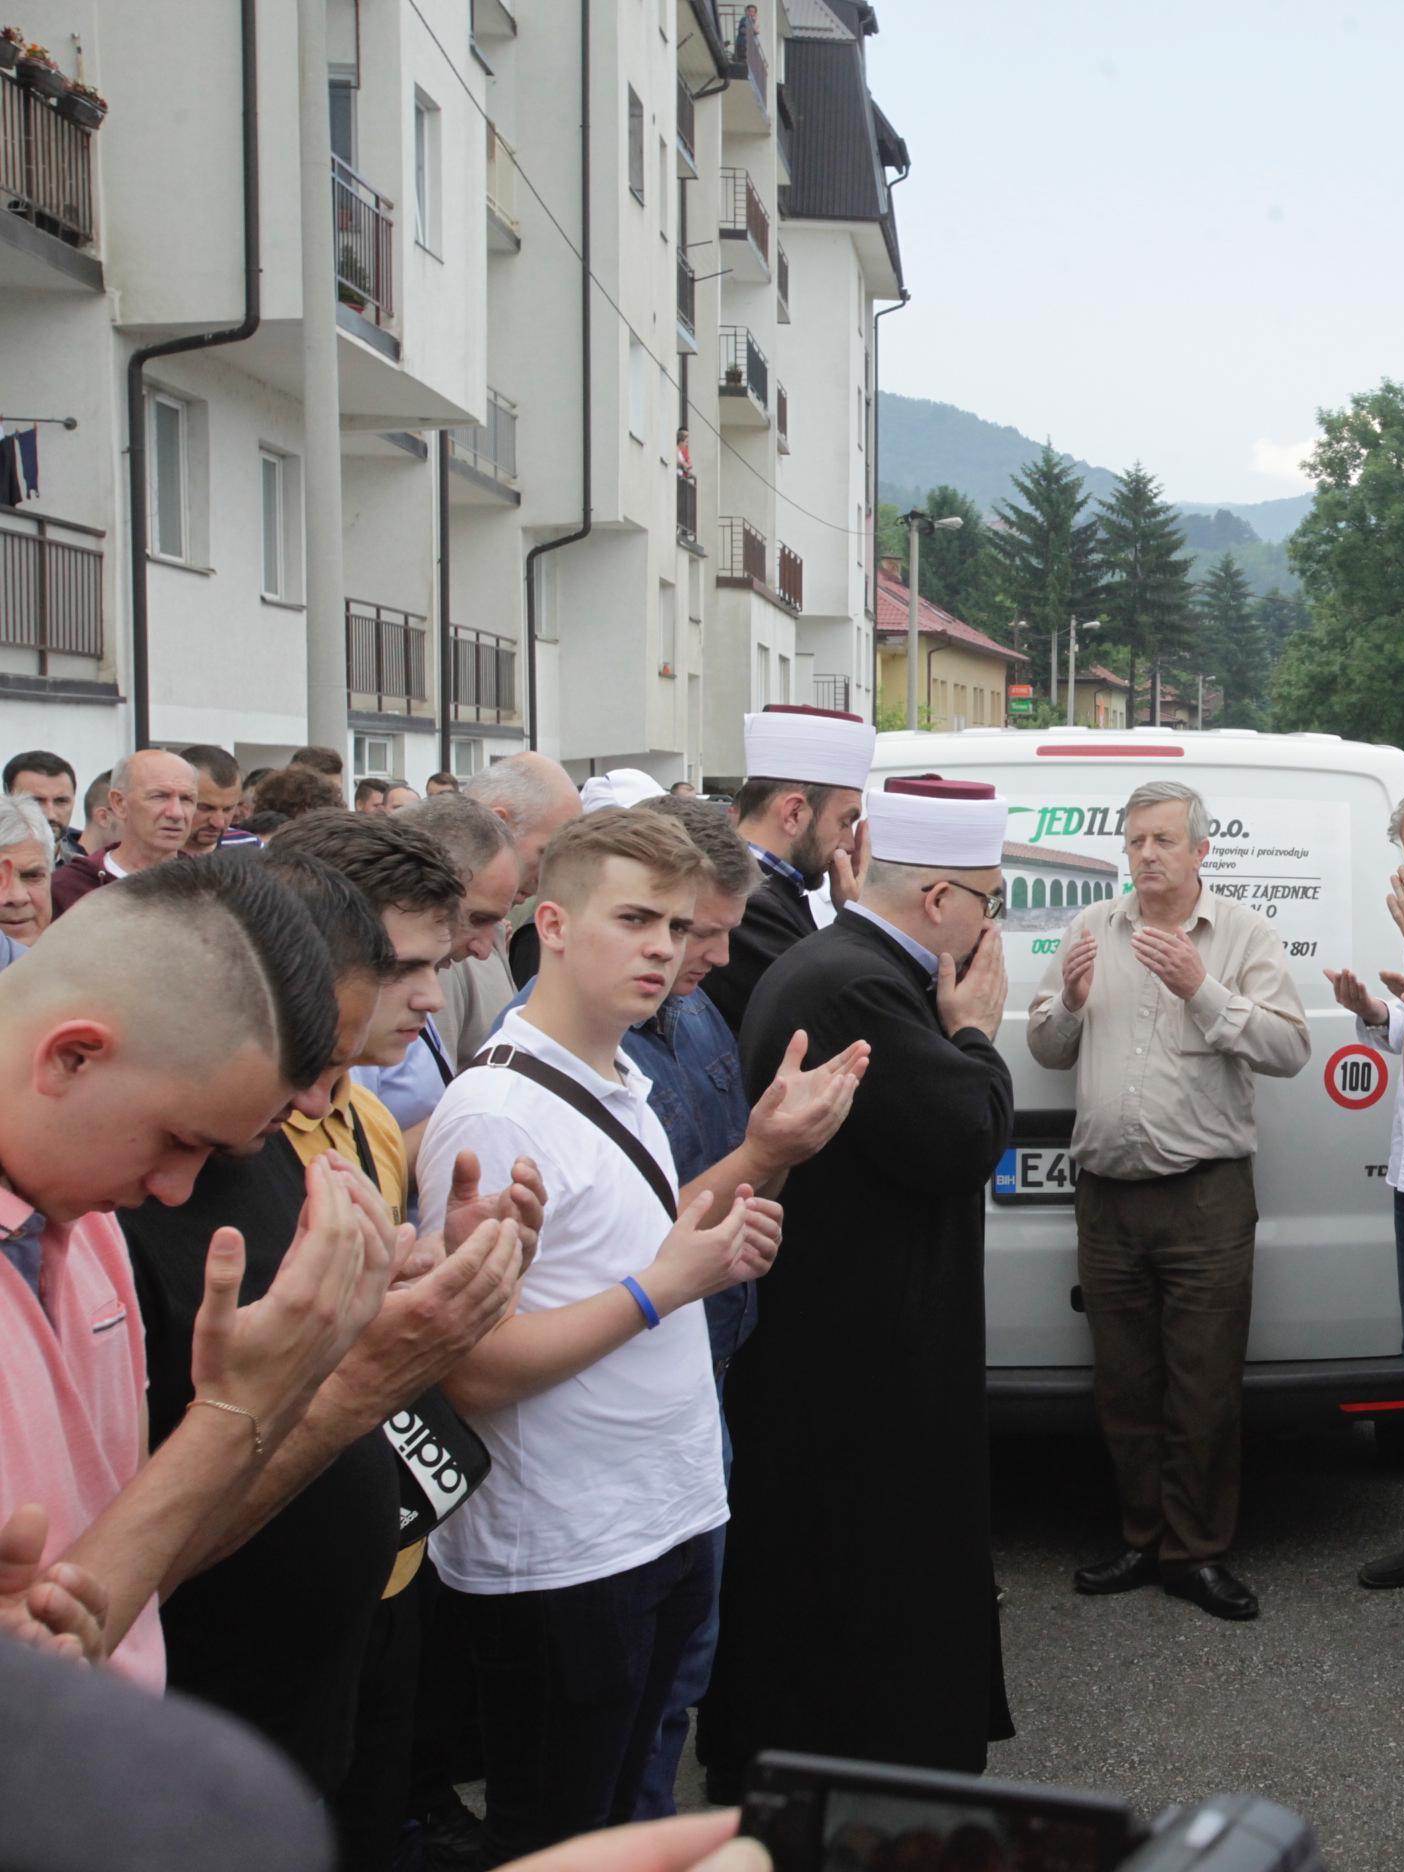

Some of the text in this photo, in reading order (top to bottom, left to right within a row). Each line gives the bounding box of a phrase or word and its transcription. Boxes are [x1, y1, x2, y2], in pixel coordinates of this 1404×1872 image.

[1211, 845, 1249, 857] trgovinu
[1256, 846, 1309, 859] proizvodnju
[1200, 860, 1236, 870] arajevo
[1252, 884, 1321, 901] ZAJEDNICE
[1341, 1061, 1371, 1092] 100
[996, 1175, 1015, 1185] BIH
